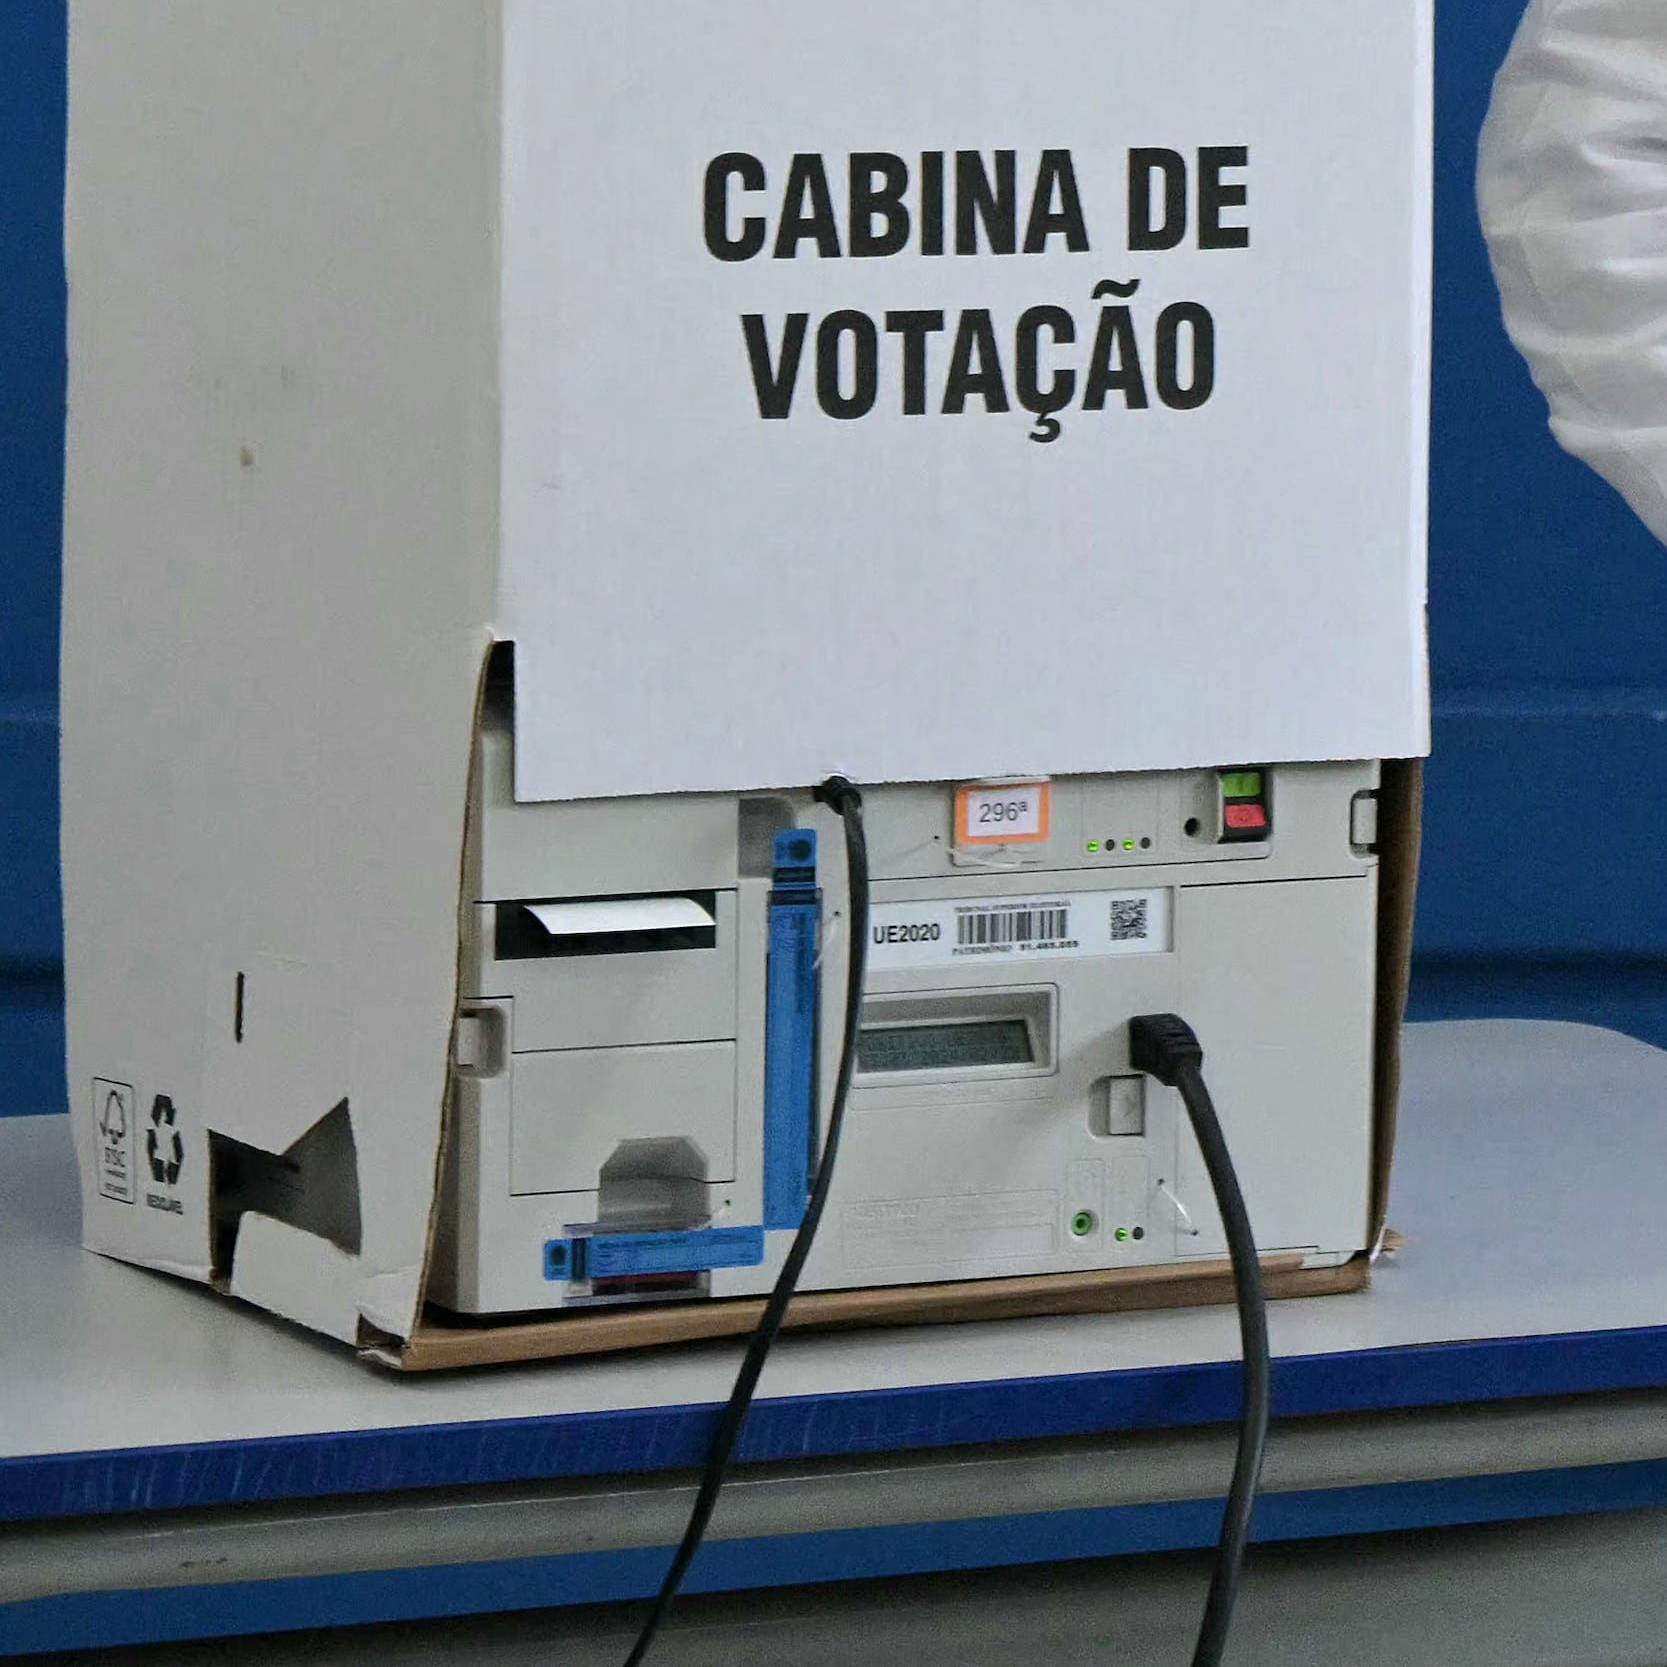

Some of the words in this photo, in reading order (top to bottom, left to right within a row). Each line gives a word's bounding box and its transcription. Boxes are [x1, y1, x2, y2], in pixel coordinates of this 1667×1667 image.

[703, 149, 1090, 262] CABINA
[1126, 145, 1250, 252] DE
[741, 278, 1216, 443] VOTAÇÃO
[872, 923, 941, 945] UE2020
